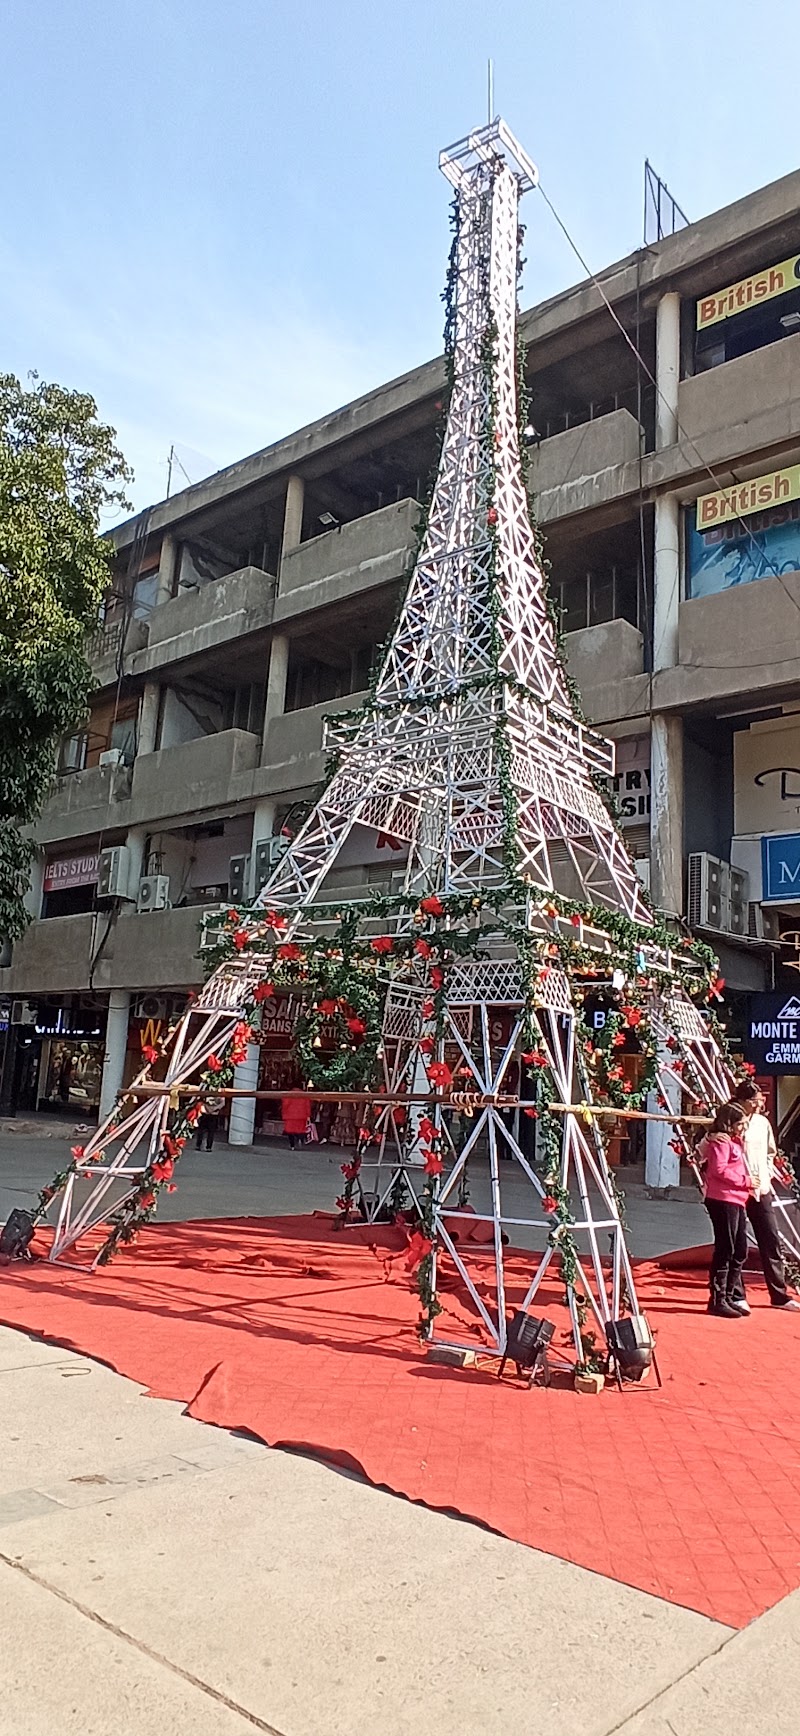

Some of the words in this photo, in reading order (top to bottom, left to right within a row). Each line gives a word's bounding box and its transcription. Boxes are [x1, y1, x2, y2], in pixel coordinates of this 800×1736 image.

[701, 270, 784, 323] British
[702, 474, 790, 523] British
[45, 863, 68, 880] IELTS
[70, 856, 101, 875] STUDY
[751, 1022, 797, 1039] MONTE
